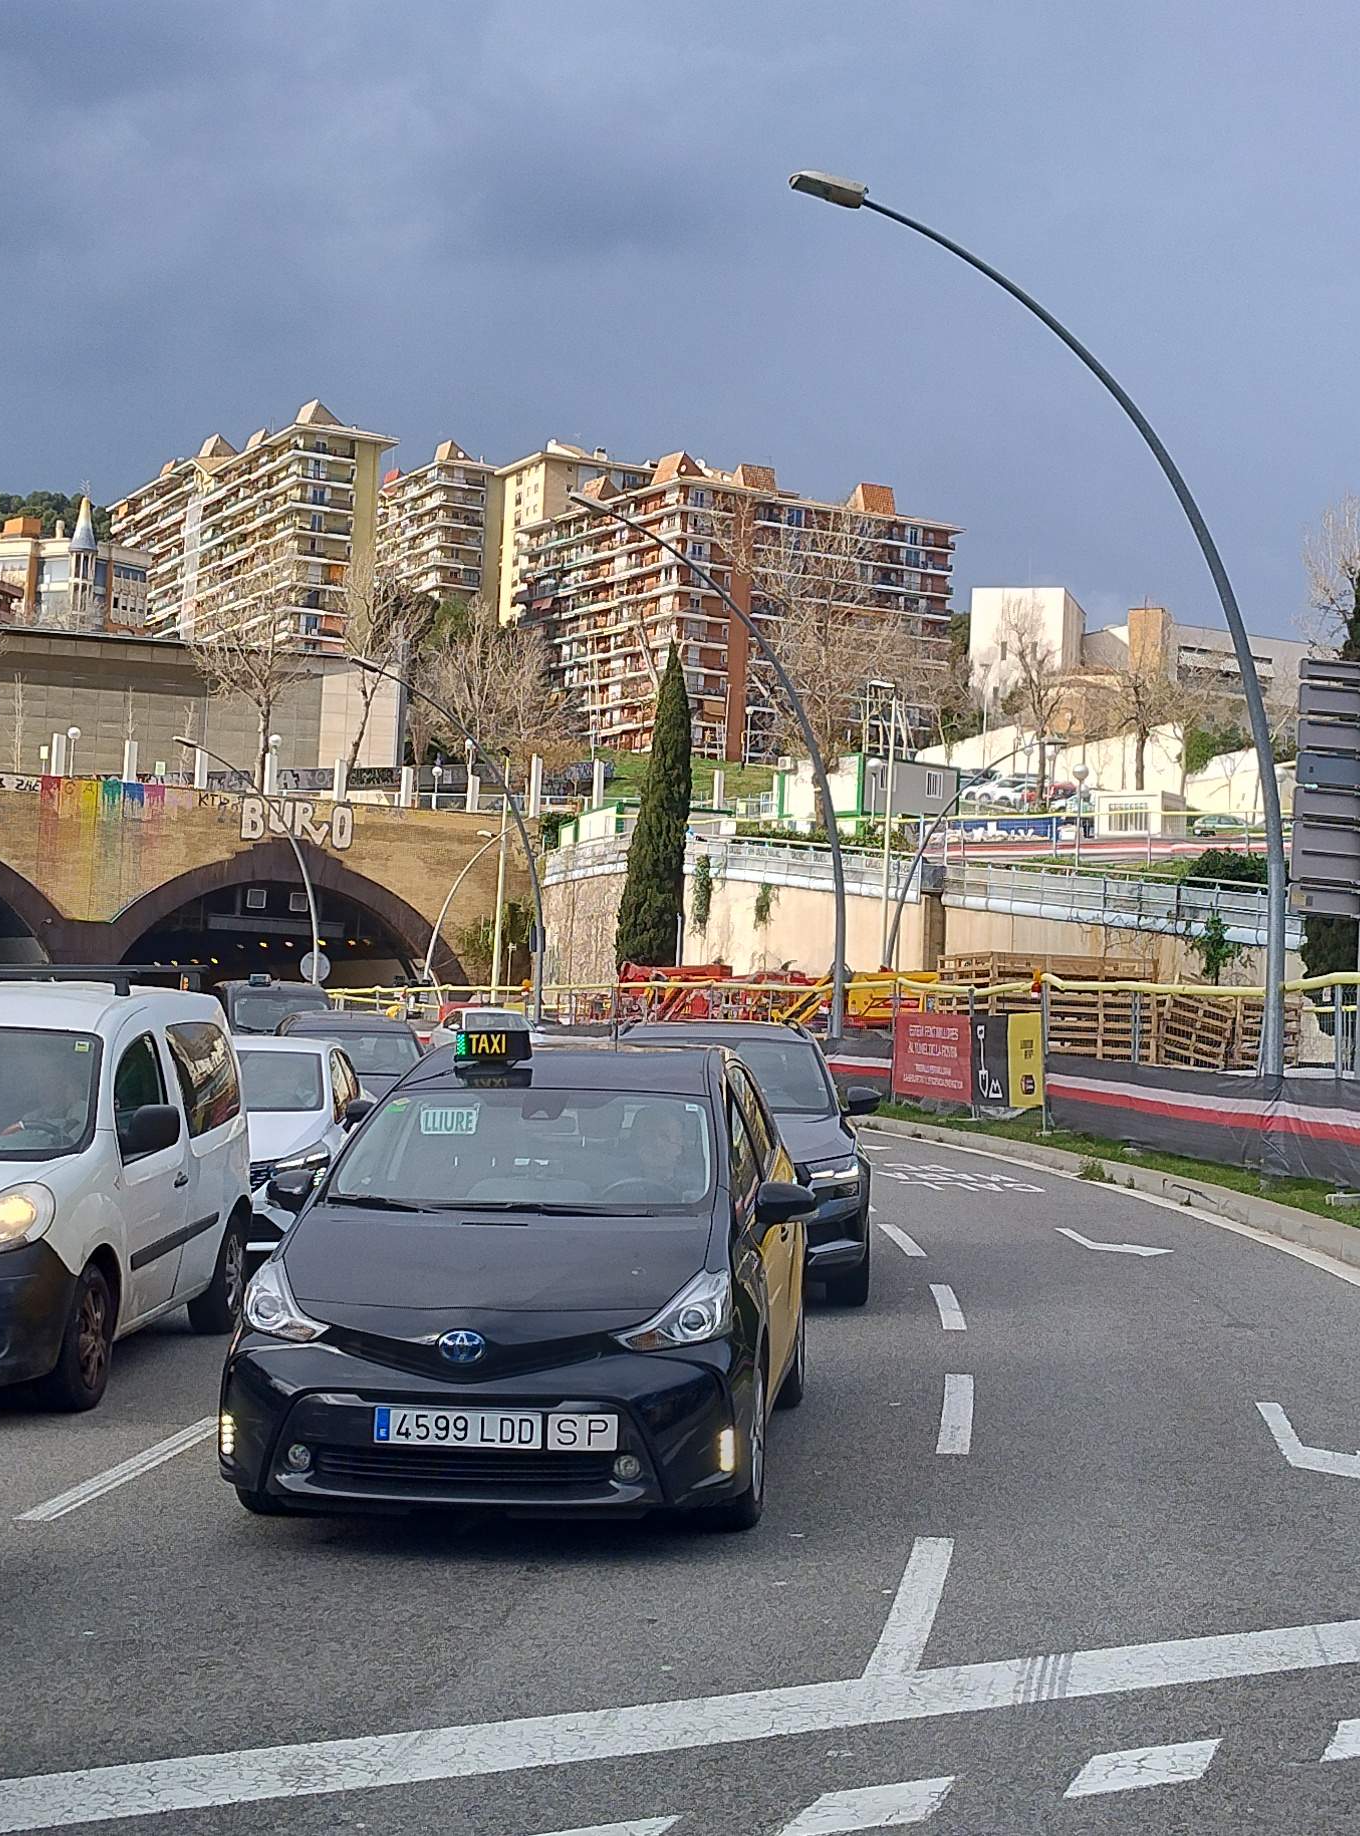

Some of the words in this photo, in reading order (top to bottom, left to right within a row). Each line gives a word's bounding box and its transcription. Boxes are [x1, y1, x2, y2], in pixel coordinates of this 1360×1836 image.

[469, 1033, 506, 1055] TAXI
[424, 1111, 474, 1132] LLIURE
[396, 1413, 469, 1442] 4599
[479, 1416, 535, 1445] LDD
